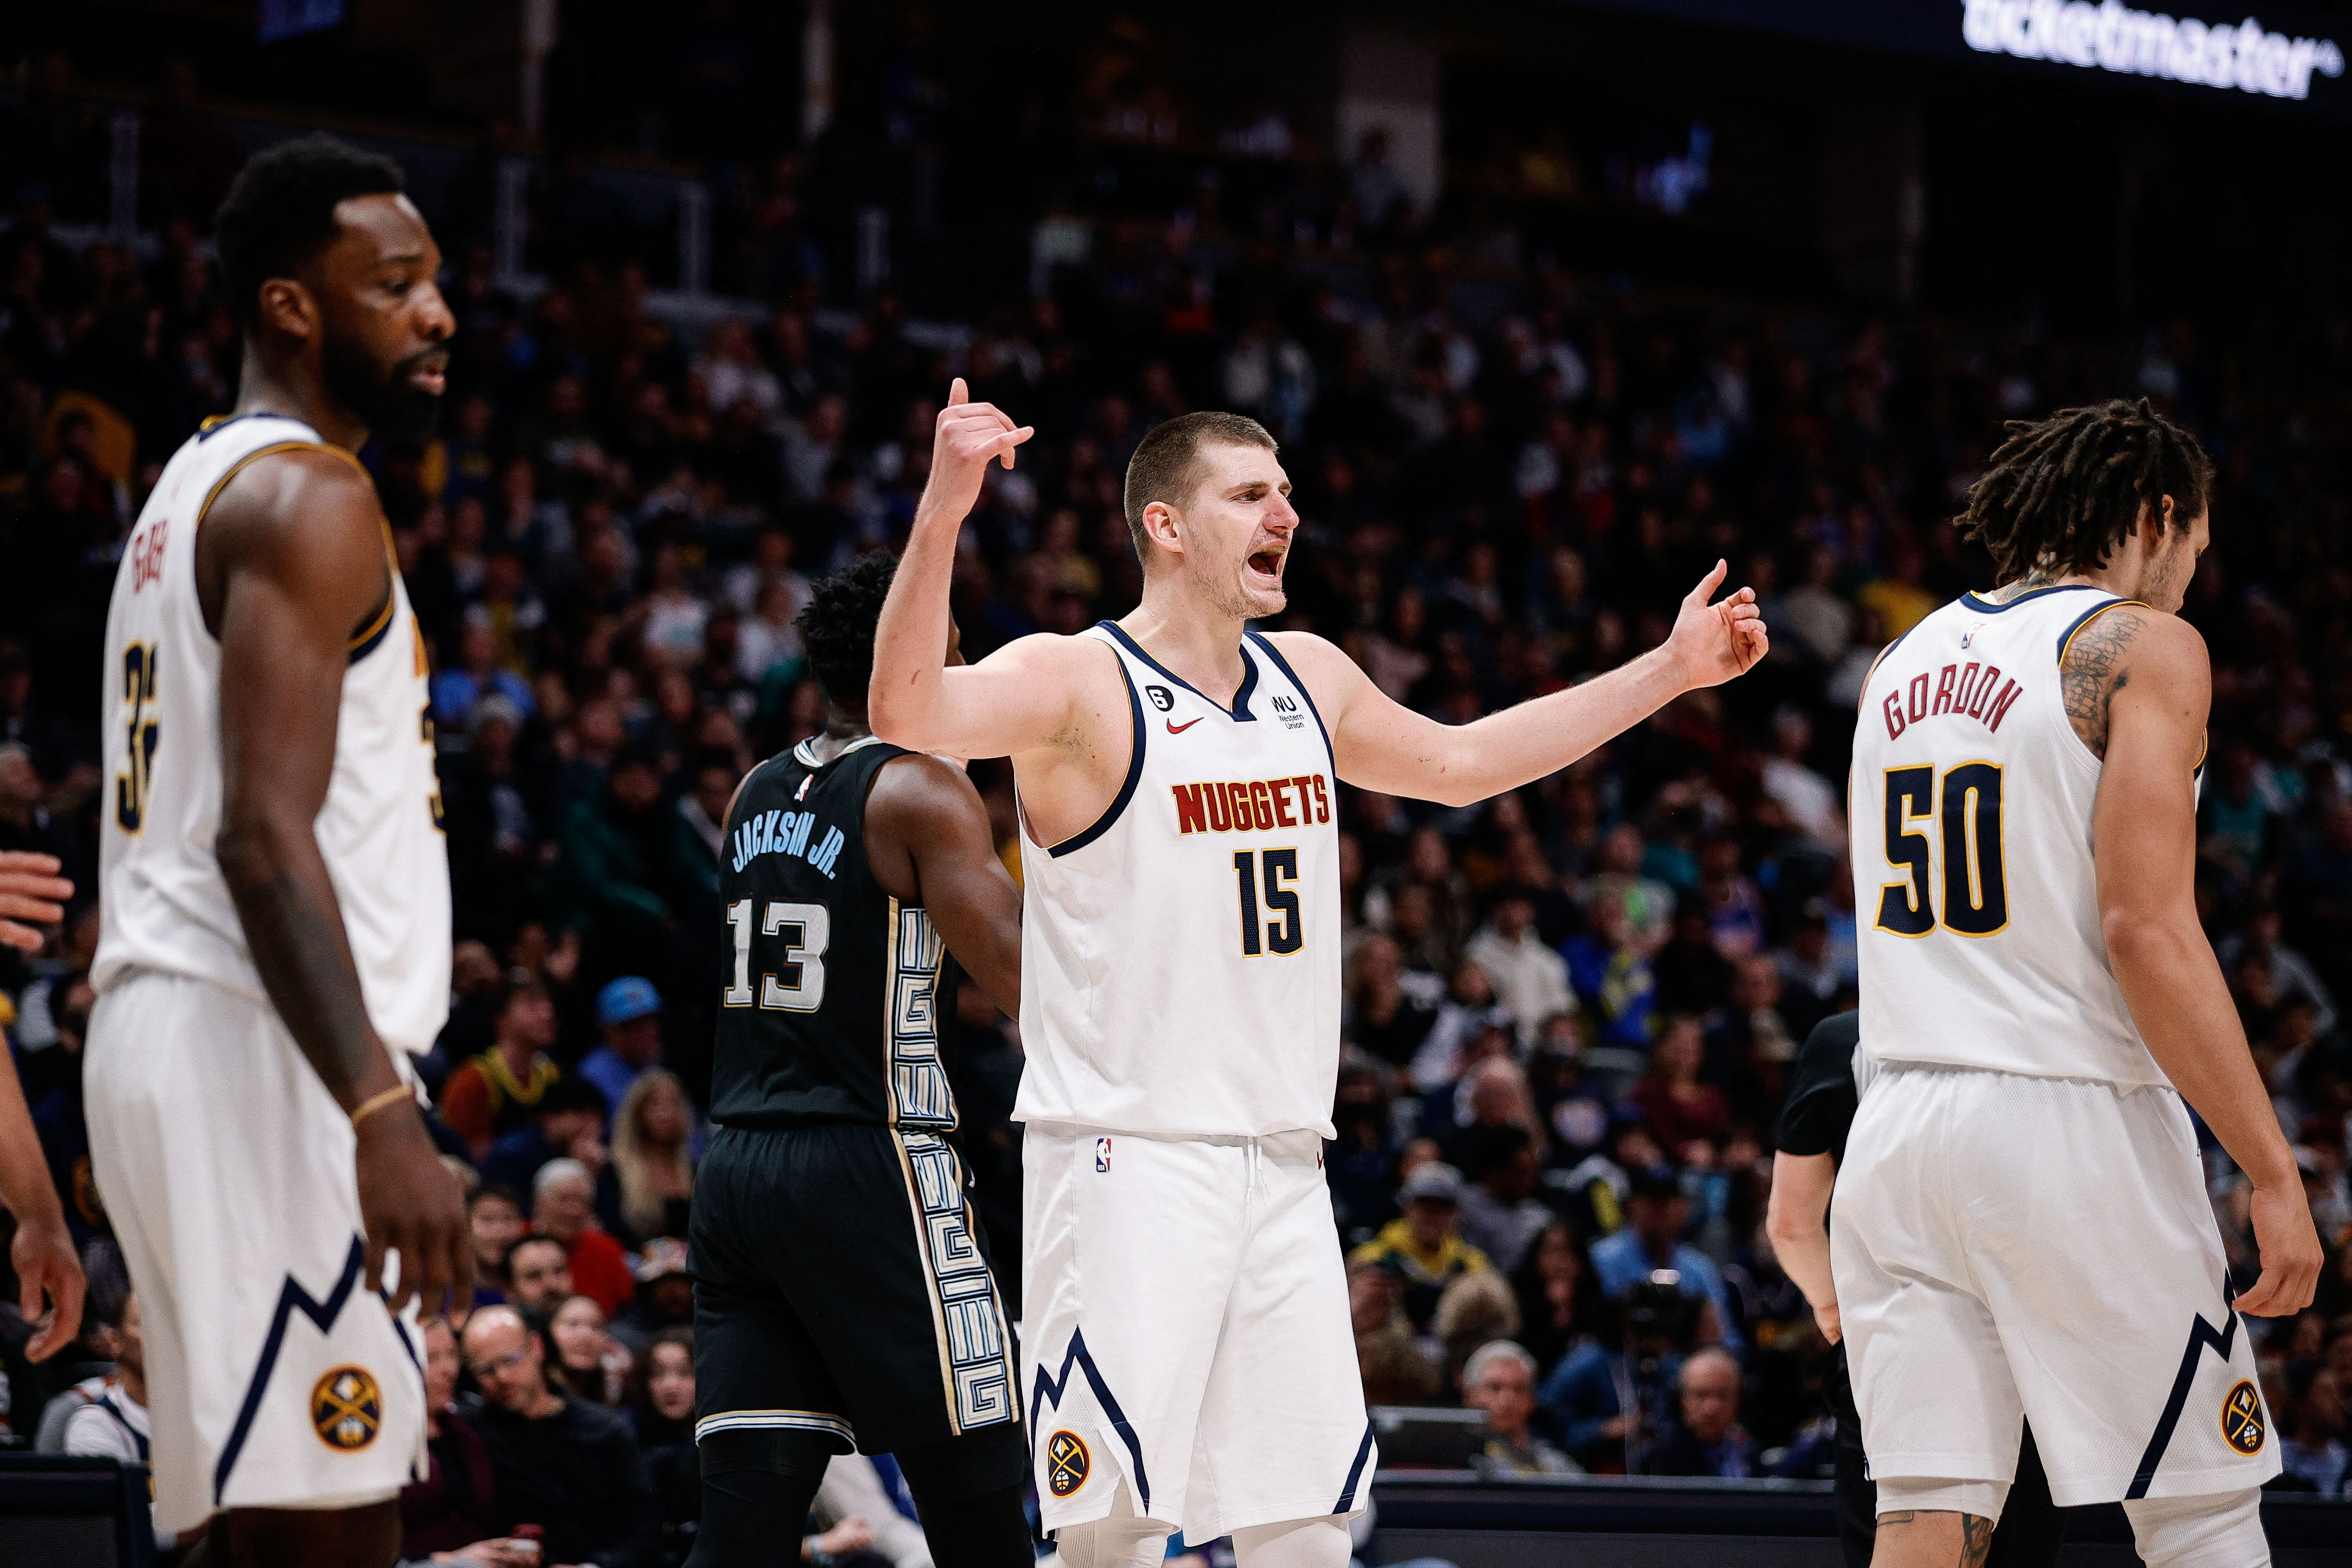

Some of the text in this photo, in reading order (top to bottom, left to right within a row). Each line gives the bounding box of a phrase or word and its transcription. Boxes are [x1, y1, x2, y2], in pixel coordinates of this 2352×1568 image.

[1148, 689, 1168, 708] 6
[1269, 696, 1297, 712] WU
[1883, 662, 2023, 740] GORDON
[1170, 773, 1330, 836] NUGGETS
[807, 825, 845, 880] JR.
[1872, 759, 2010, 938] 50
[1232, 847, 1305, 958] 15
[723, 895, 830, 1014] 13
